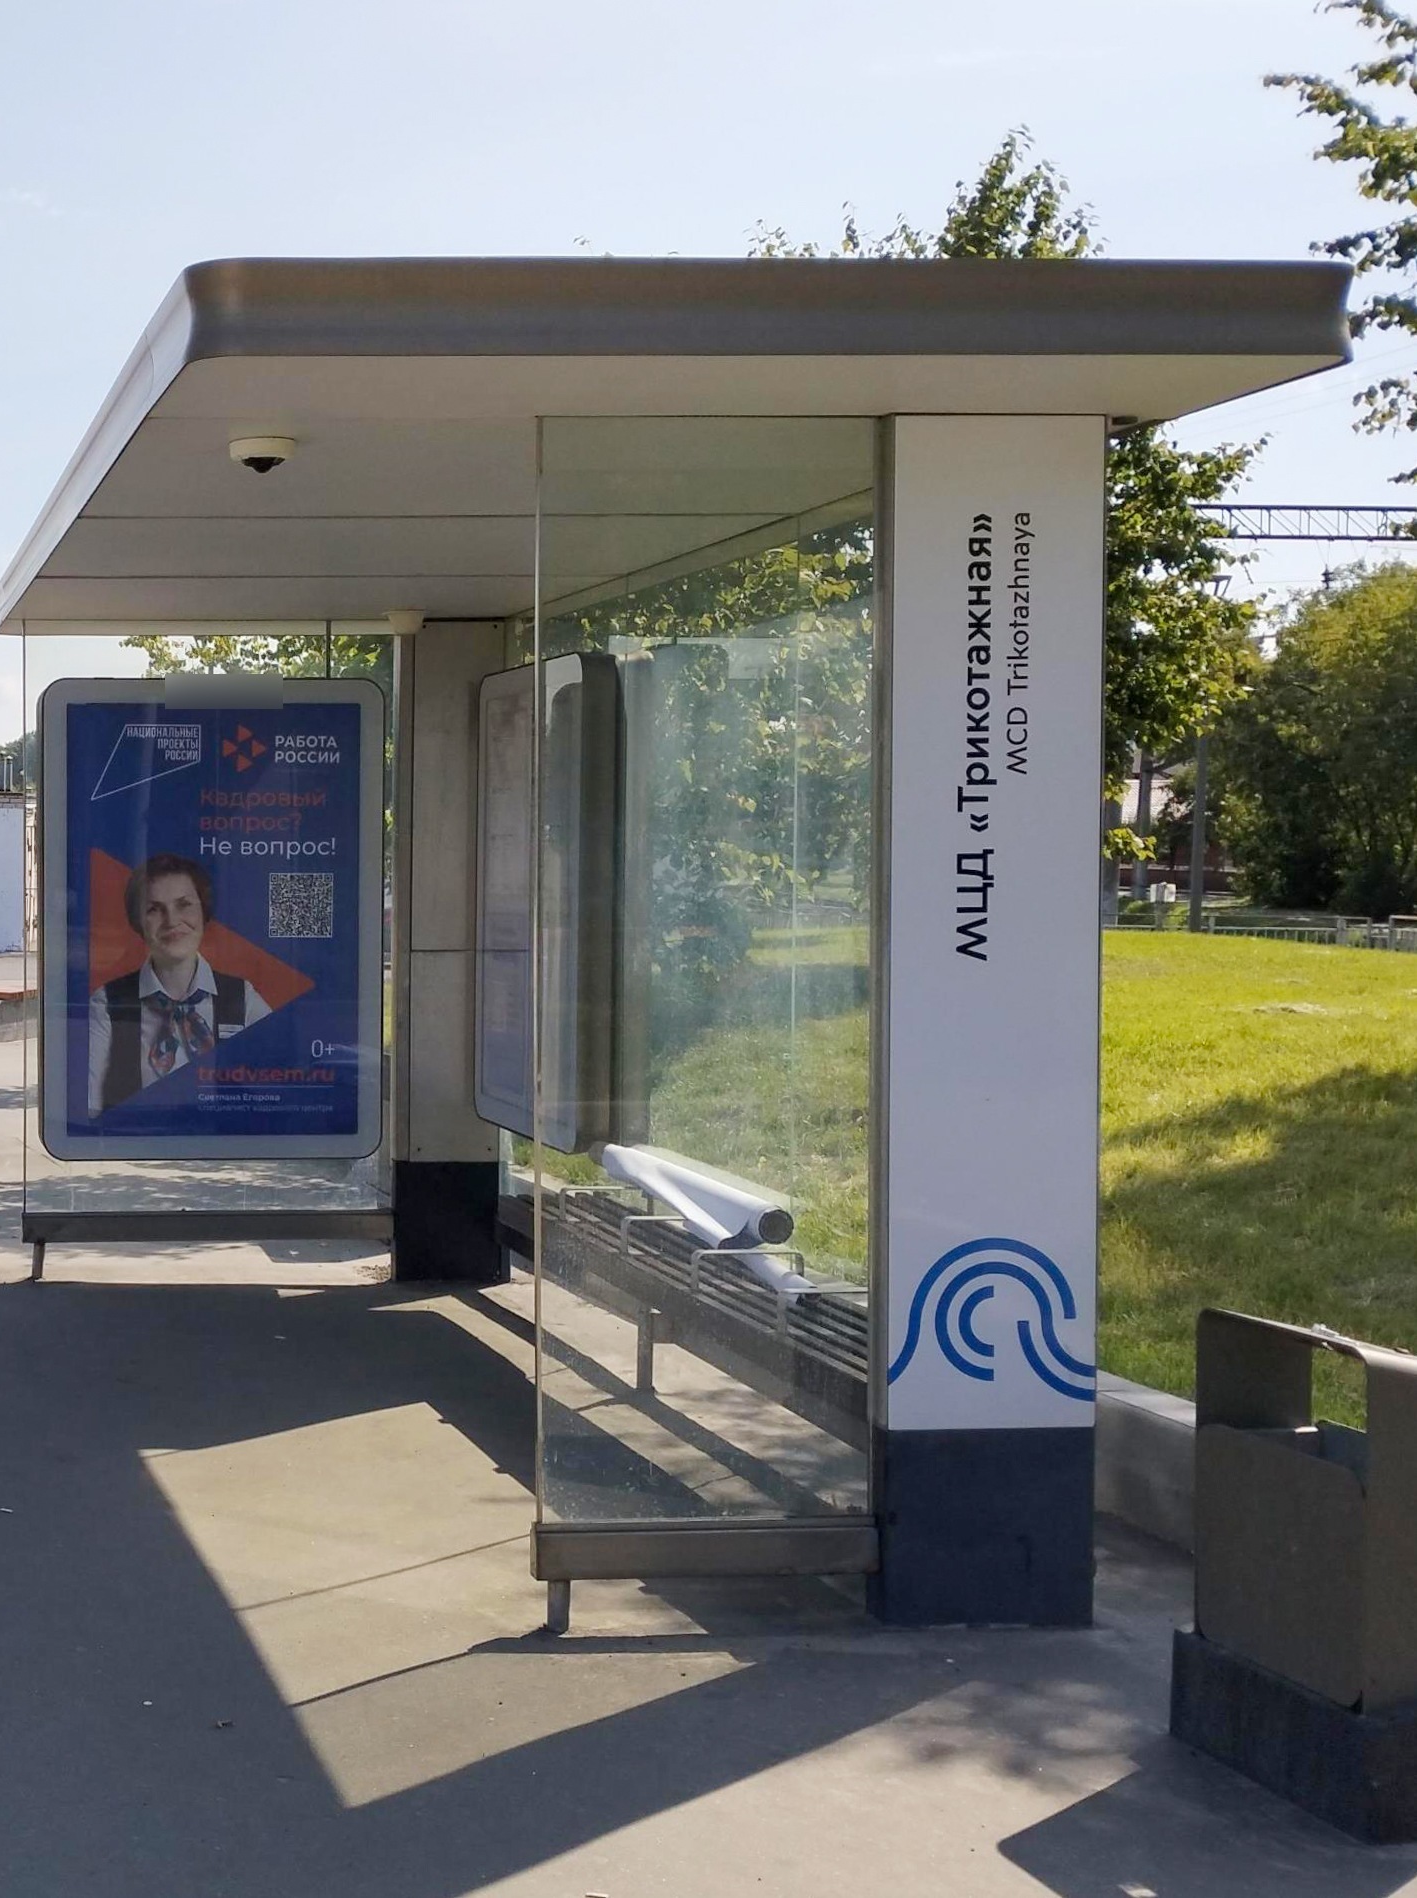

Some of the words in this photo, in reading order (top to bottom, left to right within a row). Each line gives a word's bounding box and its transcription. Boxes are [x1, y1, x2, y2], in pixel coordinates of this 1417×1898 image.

[1005, 511, 1036, 697] Trikotazhnaya
[955, 512, 999, 834] «Трикотажная»
[126, 727, 199, 739] НАЦИОНАЛЬНЫЕ
[274, 735, 338, 748] РАБОТА
[1005, 705, 1029, 775] MCD
[157, 738, 199, 749] ПРОЕКТЫ
[164, 750, 199, 761] РОССИИ
[274, 751, 340, 764] РОССИИ
[200, 787, 327, 811] Кадровый
[200, 813, 303, 834] вопрос?
[200, 836, 233, 856] Не
[240, 836, 336, 860] вопрос!
[955, 848, 996, 962] МЦД
[311, 1039, 336, 1058] 0+
[198, 1064, 336, 1083] trudvsem.ru
